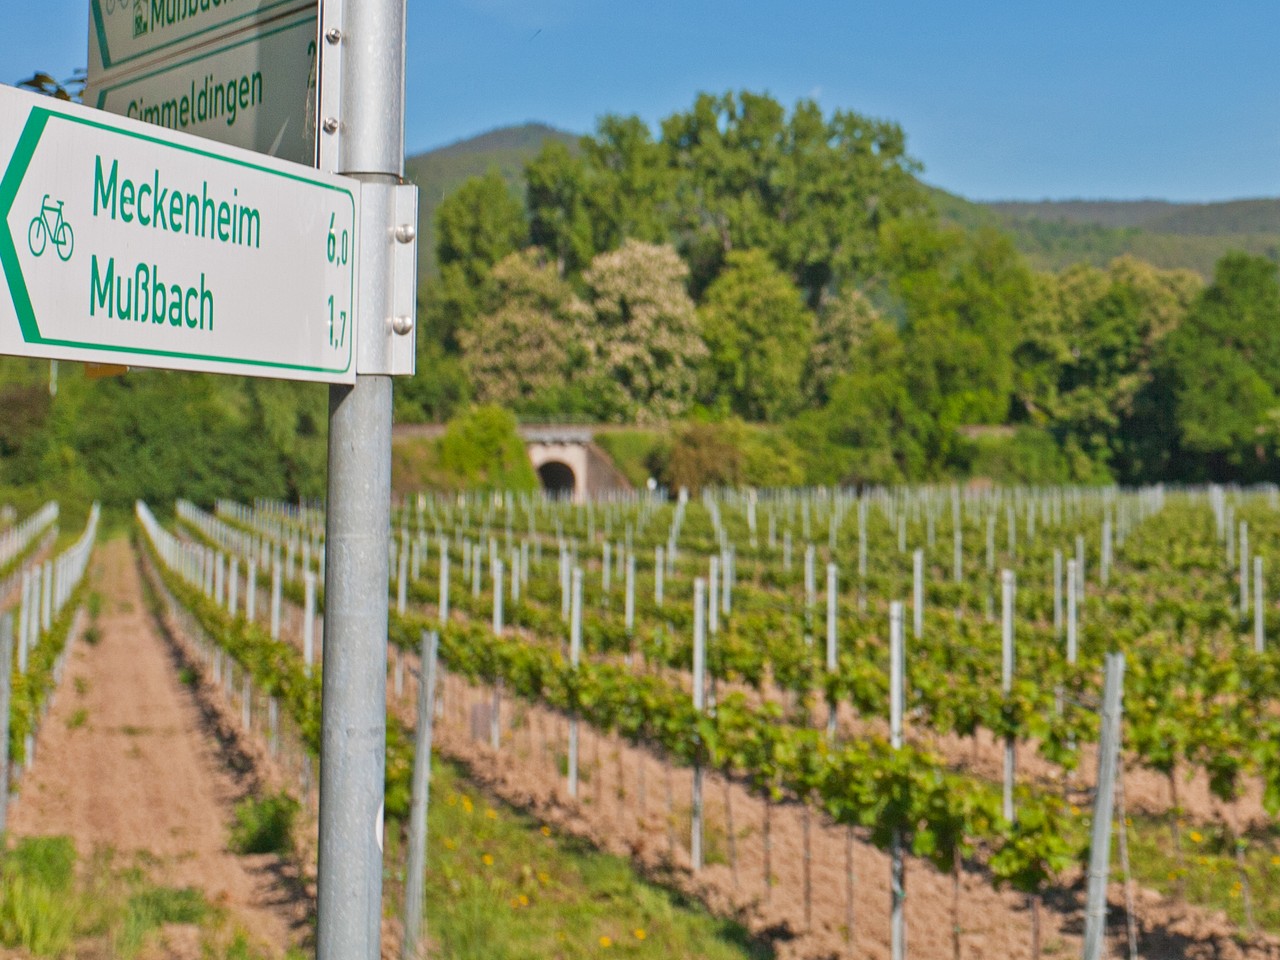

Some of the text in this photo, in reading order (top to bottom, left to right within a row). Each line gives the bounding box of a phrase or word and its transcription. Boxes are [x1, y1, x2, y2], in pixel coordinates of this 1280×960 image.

[93, 154, 348, 268] Meckenheim 6,0
[90, 254, 347, 350] Mußbach 1,7
